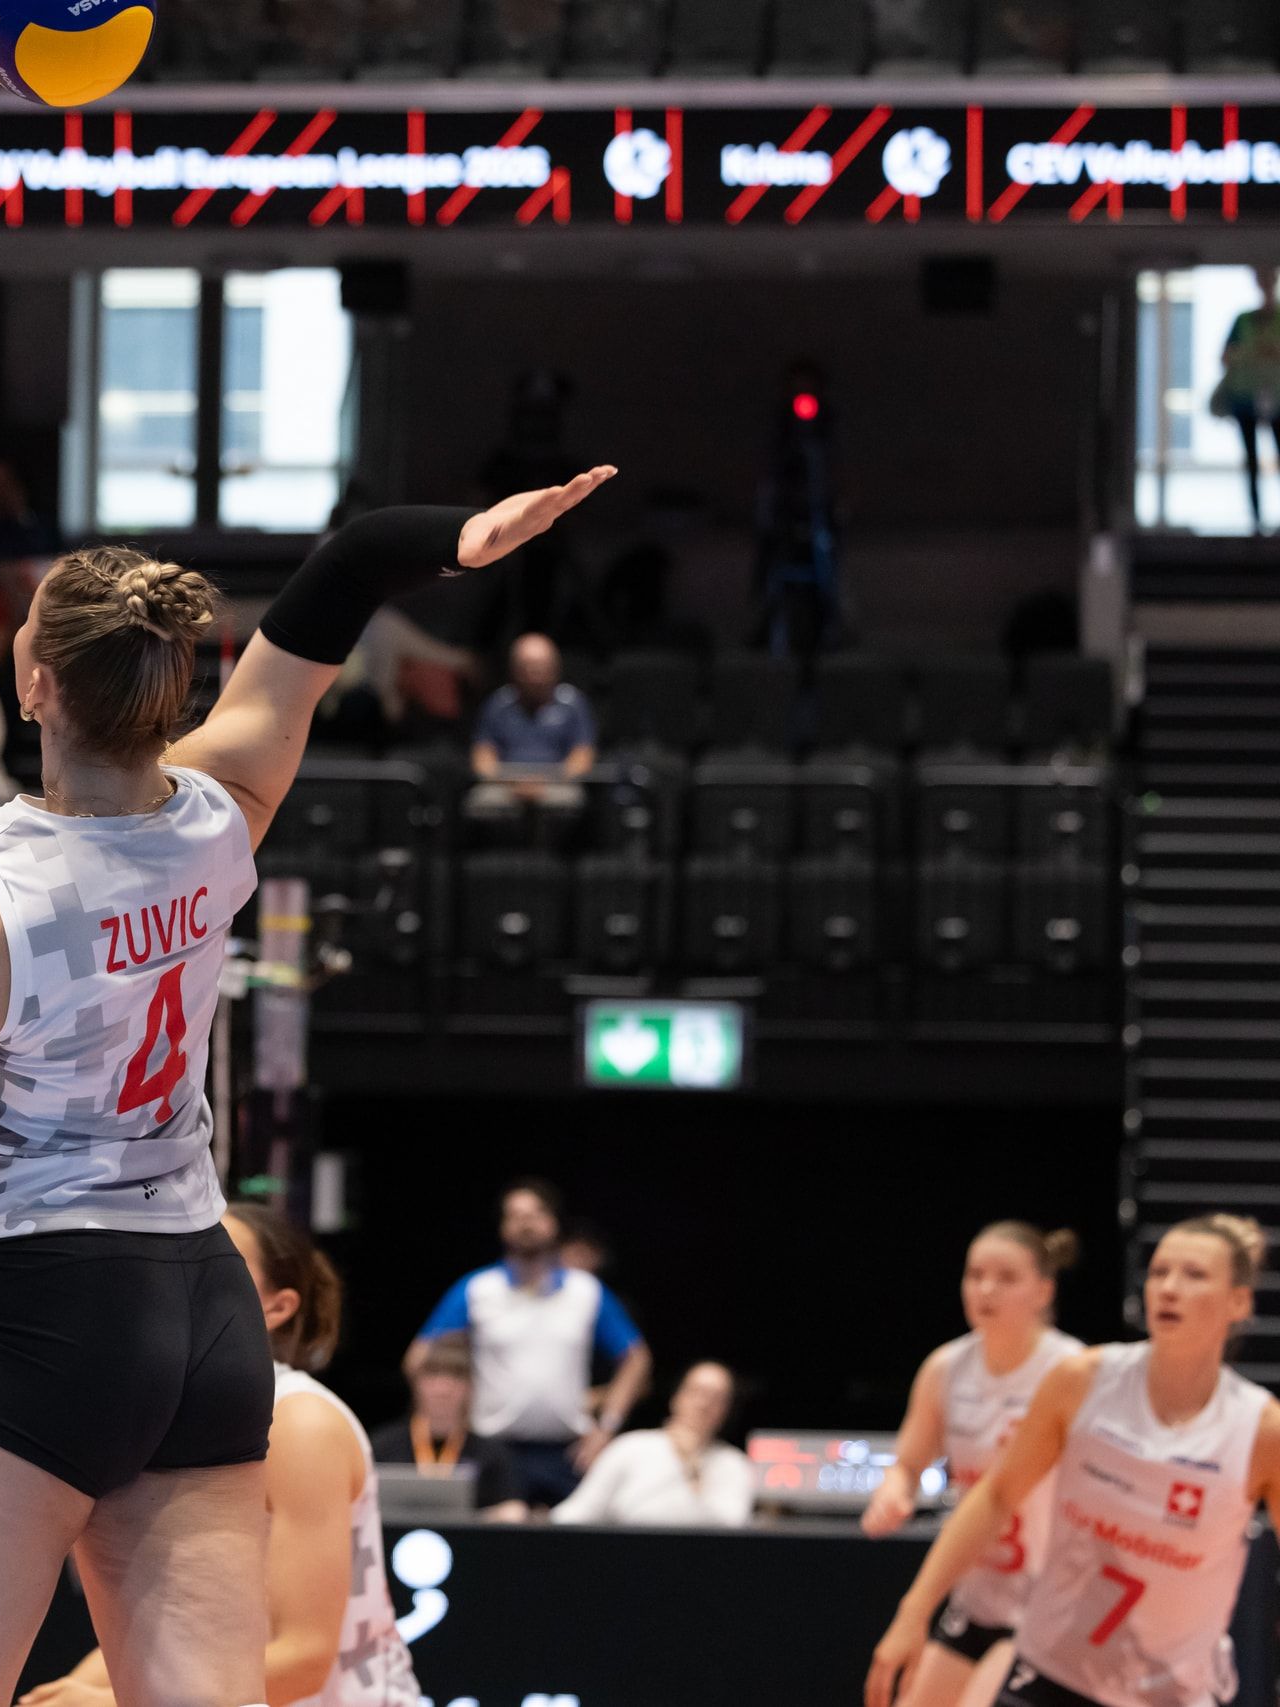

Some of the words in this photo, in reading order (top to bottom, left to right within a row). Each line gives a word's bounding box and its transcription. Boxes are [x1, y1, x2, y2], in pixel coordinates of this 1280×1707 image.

[100, 887, 208, 974] ZUVIC
[116, 961, 187, 1124] 4
[1088, 1564, 1147, 1647] 7
